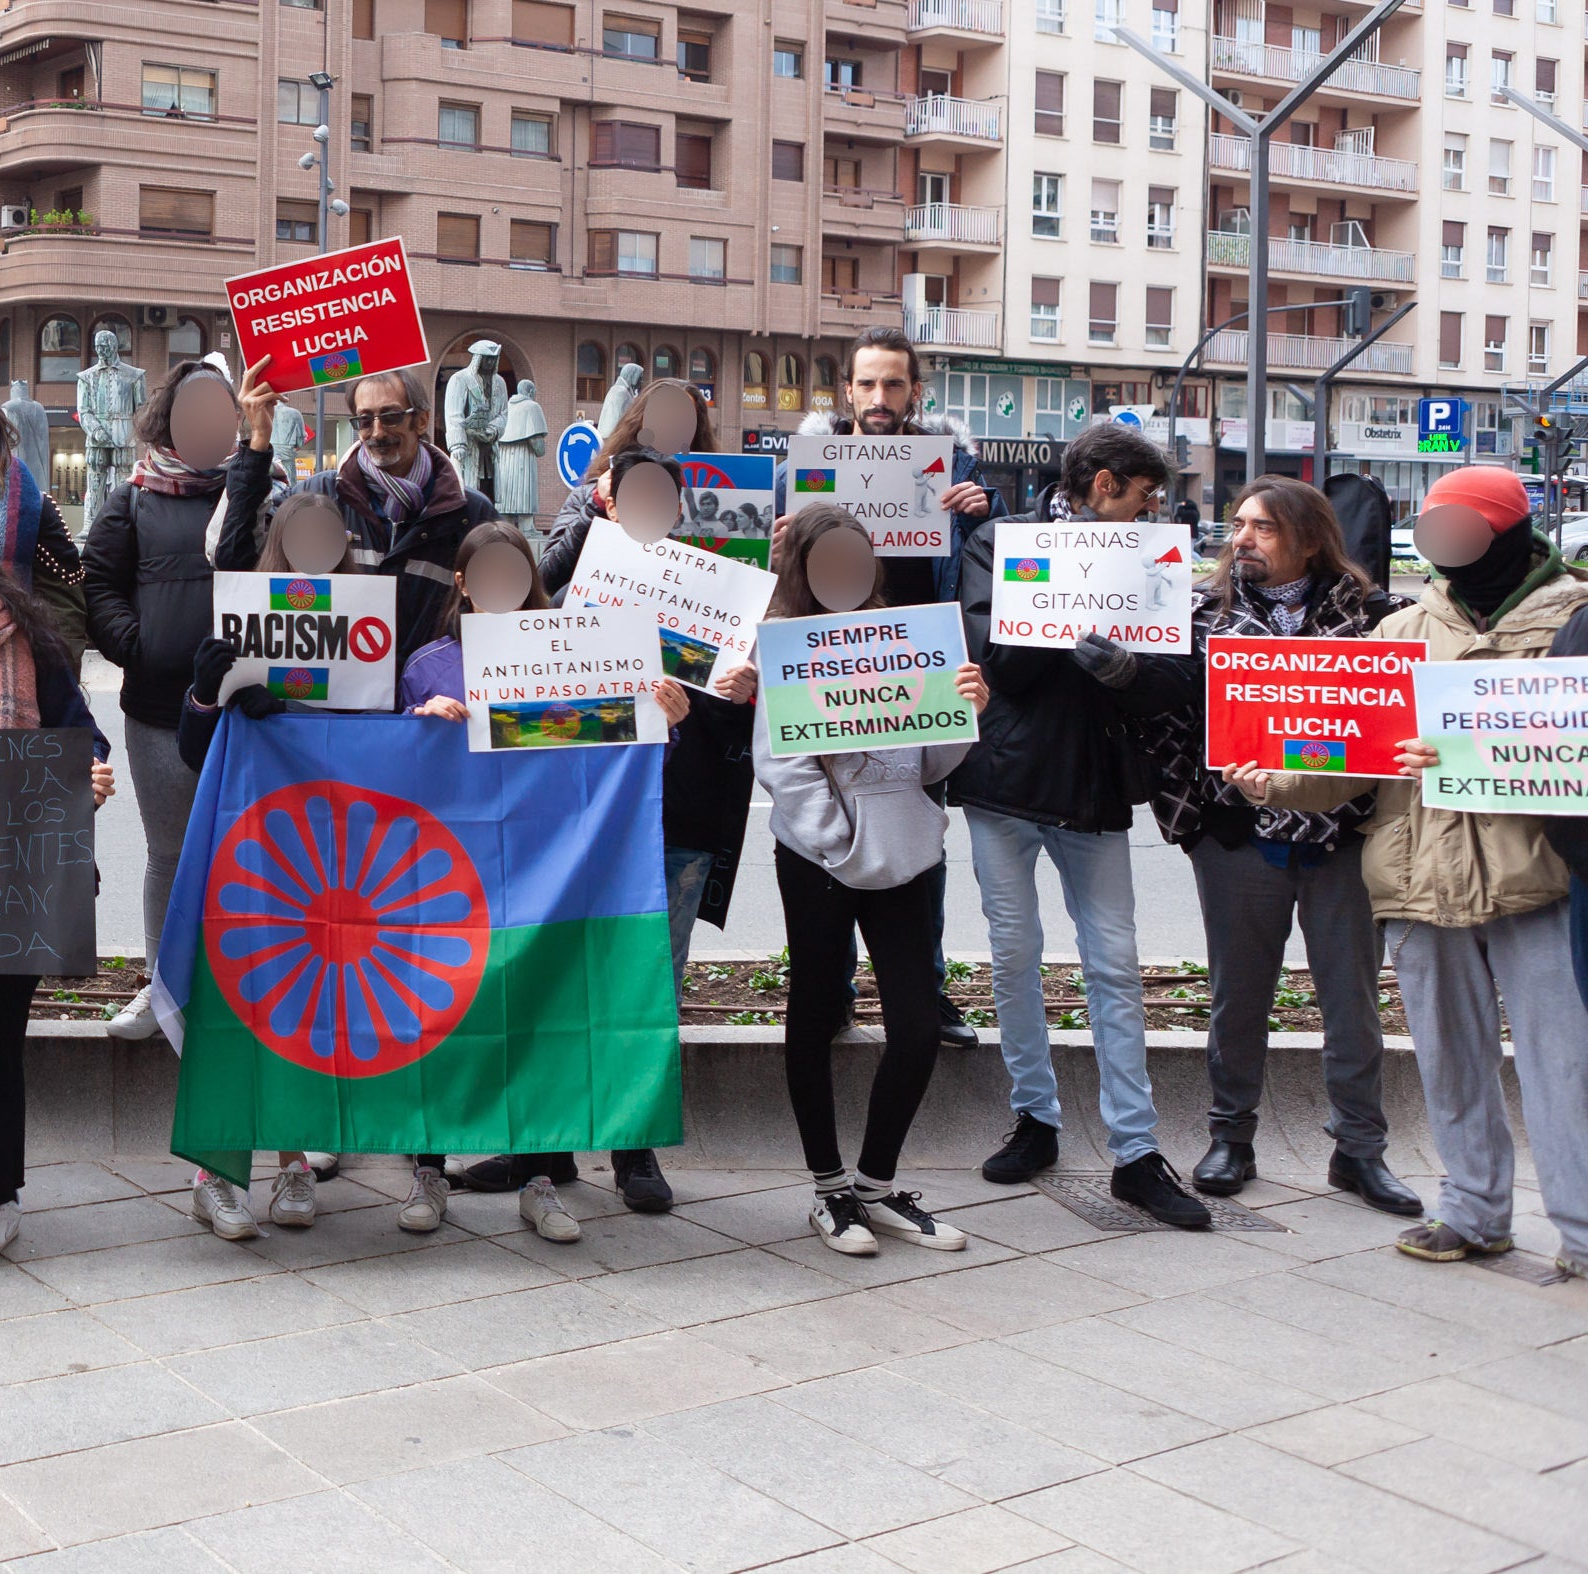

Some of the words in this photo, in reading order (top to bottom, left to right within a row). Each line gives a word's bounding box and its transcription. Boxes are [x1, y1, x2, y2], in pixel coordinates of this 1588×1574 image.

[232, 254, 402, 309] ORGANIZACIÓN
[251, 287, 397, 336] RESISTENCIA
[291, 325, 369, 358] LUCHA
[1429, 402, 1451, 431] P
[1364, 427, 1402, 440] Obstetrix
[823, 444, 912, 461] GITANAS
[983, 441, 1051, 465] MIYAKO
[861, 473, 873, 489] Y
[1036, 532, 1139, 549] GITANAS
[662, 569, 684, 586] EL
[1080, 563, 1093, 578] Y
[590, 569, 743, 628] ANTIGITANISMO
[1031, 592, 1138, 611] GITANOS
[519, 615, 601, 632] CONTRA
[571, 584, 590, 596] NI
[687, 623, 748, 653] ATRÁS
[999, 620, 1033, 637] NO
[551, 640, 573, 652] EL
[806, 623, 908, 648] SIEMPRE
[482, 658, 644, 679] ANTIGITANISMO
[782, 650, 946, 680] PERSEGUIDOS
[1211, 651, 1421, 675] ORGANIZACIÓN
[469, 690, 489, 702] NI
[499, 687, 525, 700] UN
[535, 684, 587, 699] PASO
[597, 677, 662, 696] ATRÁS
[824, 685, 910, 708] NUNCA
[1225, 684, 1406, 707] RESISTENCIA
[780, 710, 968, 743] EXTERMINADOS
[1267, 717, 1362, 738] LUCHA
[21, 766, 73, 794] LA
[7, 798, 66, 826] LOS
